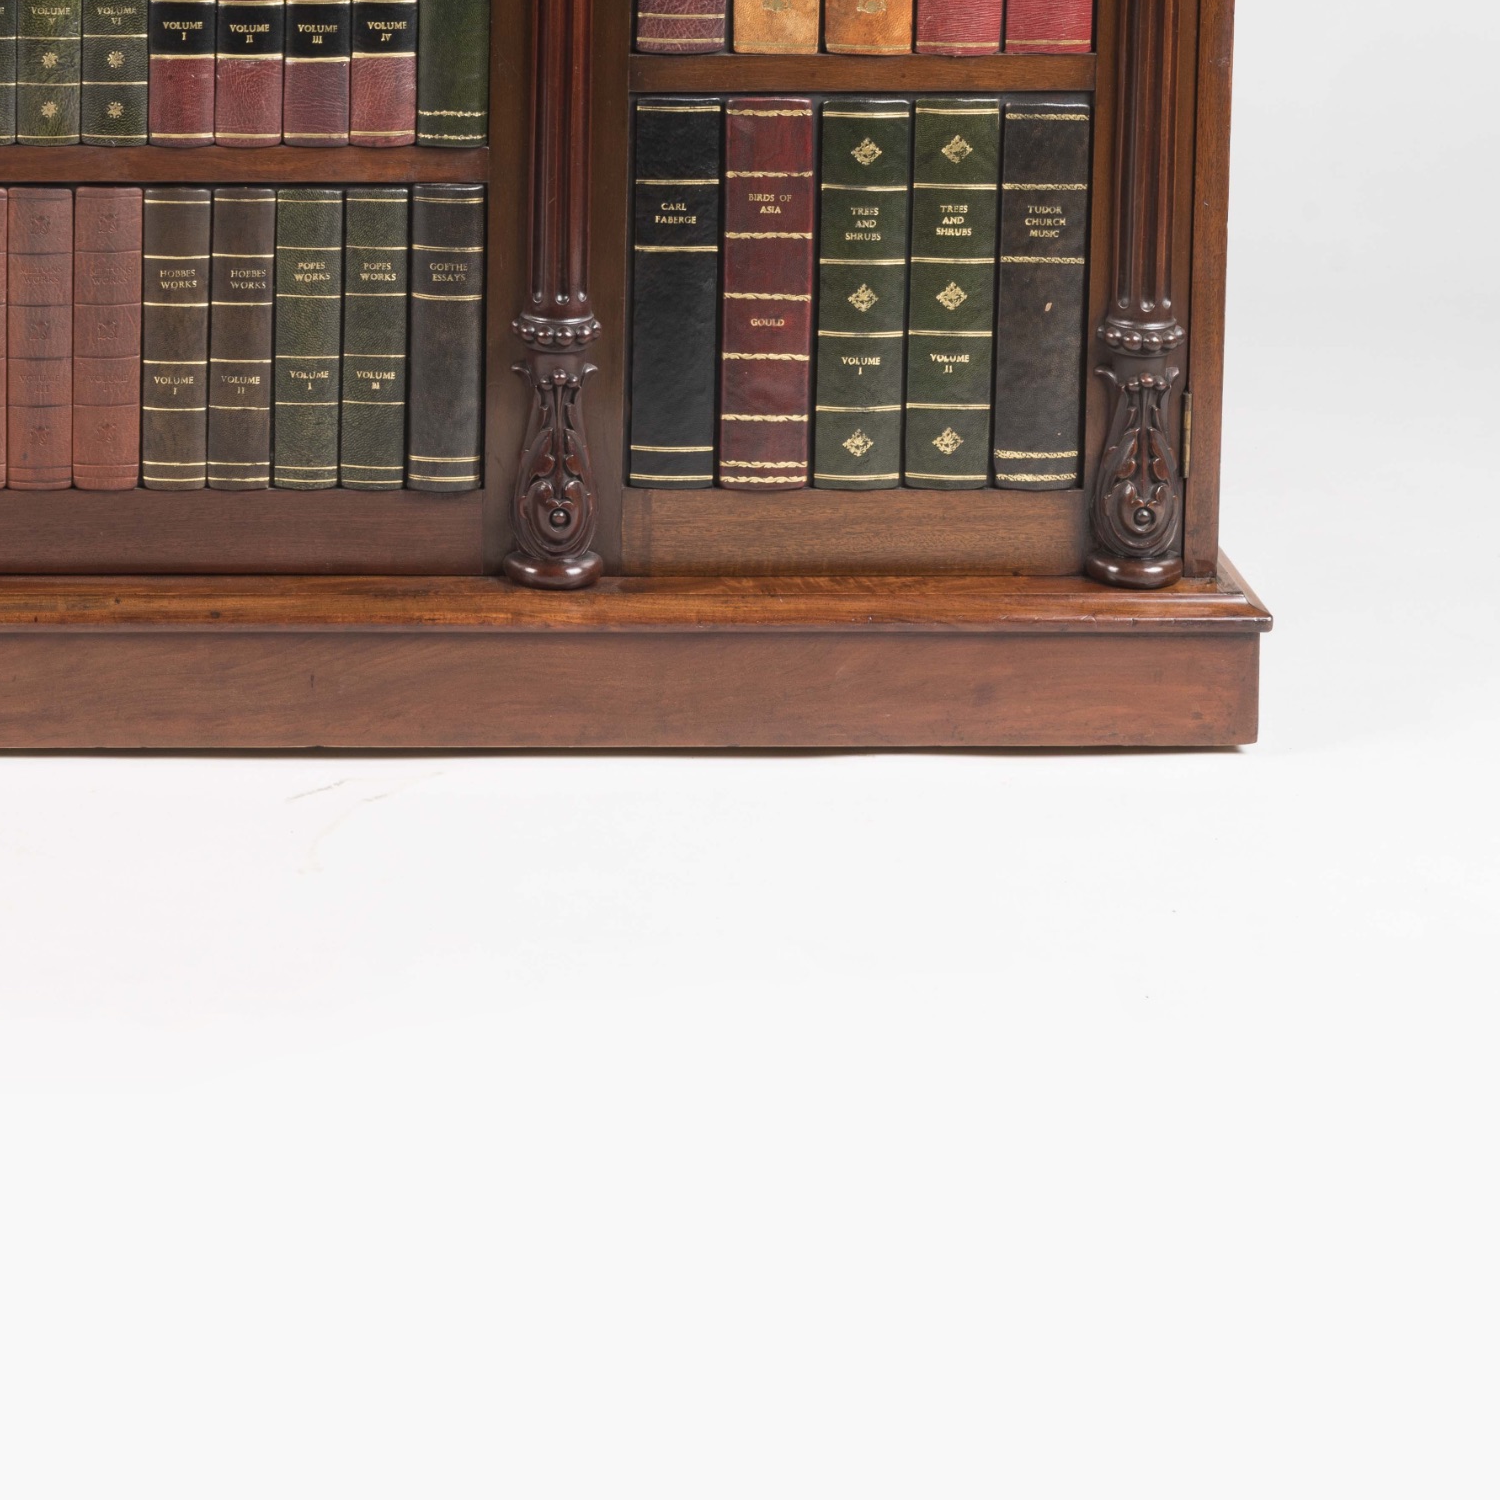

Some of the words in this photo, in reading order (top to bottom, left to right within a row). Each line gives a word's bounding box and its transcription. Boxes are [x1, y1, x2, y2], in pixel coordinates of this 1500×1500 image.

[31, 7, 71, 15] VOLUME
[97, 7, 137, 15] VOLUME
[111, 17, 122, 25] VI
[163, 21, 203, 30] VOLUME
[367, 21, 407, 30] VOLUME
[230, 24, 270, 33] VOLUME
[298, 24, 338, 33] VOLUME
[182, 32, 187, 40] I
[246, 34, 253, 43] II
[312, 35, 323, 44] III
[381, 32, 392, 41] IV
[748, 194, 775, 202] BIRDS
[661, 203, 686, 211] CARL
[760, 206, 781, 214] ASIA
[940, 205, 968, 213] TREES
[1028, 206, 1062, 214] TUDOR
[851, 208, 879, 216] TREES
[655, 216, 697, 224] FABERGE
[856, 220, 876, 228] AND
[943, 216, 964, 224] AND
[1025, 218, 1066, 226] CHURCH
[936, 227, 972, 236] SHRUBS
[845, 232, 881, 241] SHRUBS
[298, 262, 326, 271] POPES
[364, 262, 392, 271] POPES
[430, 263, 468, 272] GOETHE
[160, 269, 196, 278] HOBBES
[231, 269, 266, 278] HOBBES
[294, 272, 330, 283] WORKS
[360, 272, 396, 281] WORKS
[432, 273, 466, 282] ESSAYS
[161, 280, 197, 289] WORKS
[230, 281, 266, 289] WORKS
[751, 318, 785, 326] GOULD
[842, 357, 881, 365] VOLUME
[930, 354, 969, 362] VOLUME
[858, 366, 862, 375] I
[943, 365, 953, 374] II
[221, 375, 260, 384] VOLUME
[290, 370, 329, 380] VOLUME
[356, 371, 396, 380] VOLUME
[154, 376, 194, 385] VOLUME
[238, 386, 245, 395] II
[307, 382, 312, 390] I
[172, 387, 177, 395] I
